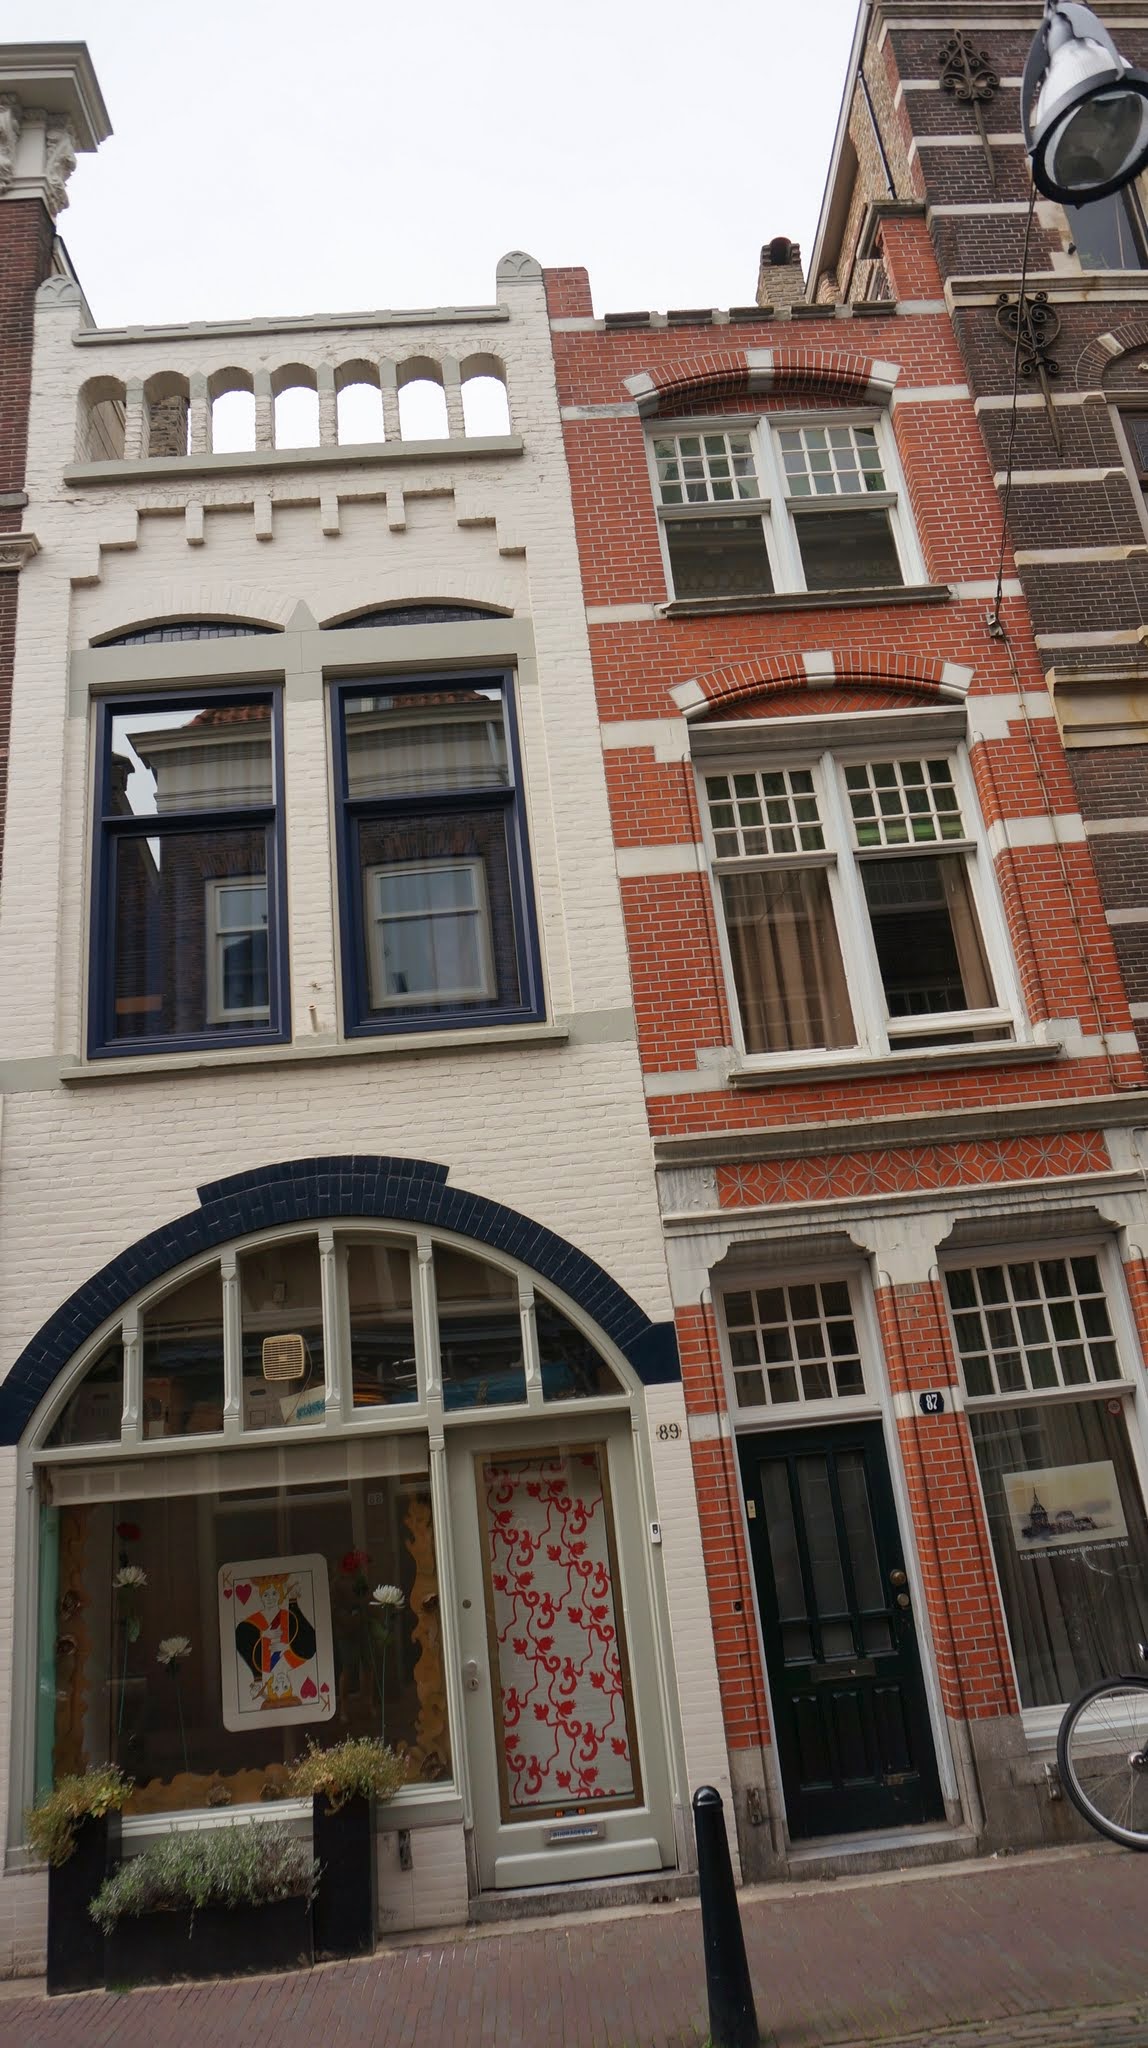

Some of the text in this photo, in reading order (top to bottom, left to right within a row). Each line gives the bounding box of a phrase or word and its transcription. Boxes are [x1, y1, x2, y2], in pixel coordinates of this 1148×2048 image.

[925, 1393, 938, 1410] 87
[659, 1423, 679, 1440] 89
[1020, 1551, 1046, 1561] Expositie
[1093, 1543, 1116, 1551] nummer
[222, 1569, 233, 1587] K
[319, 1694, 331, 1712] K
